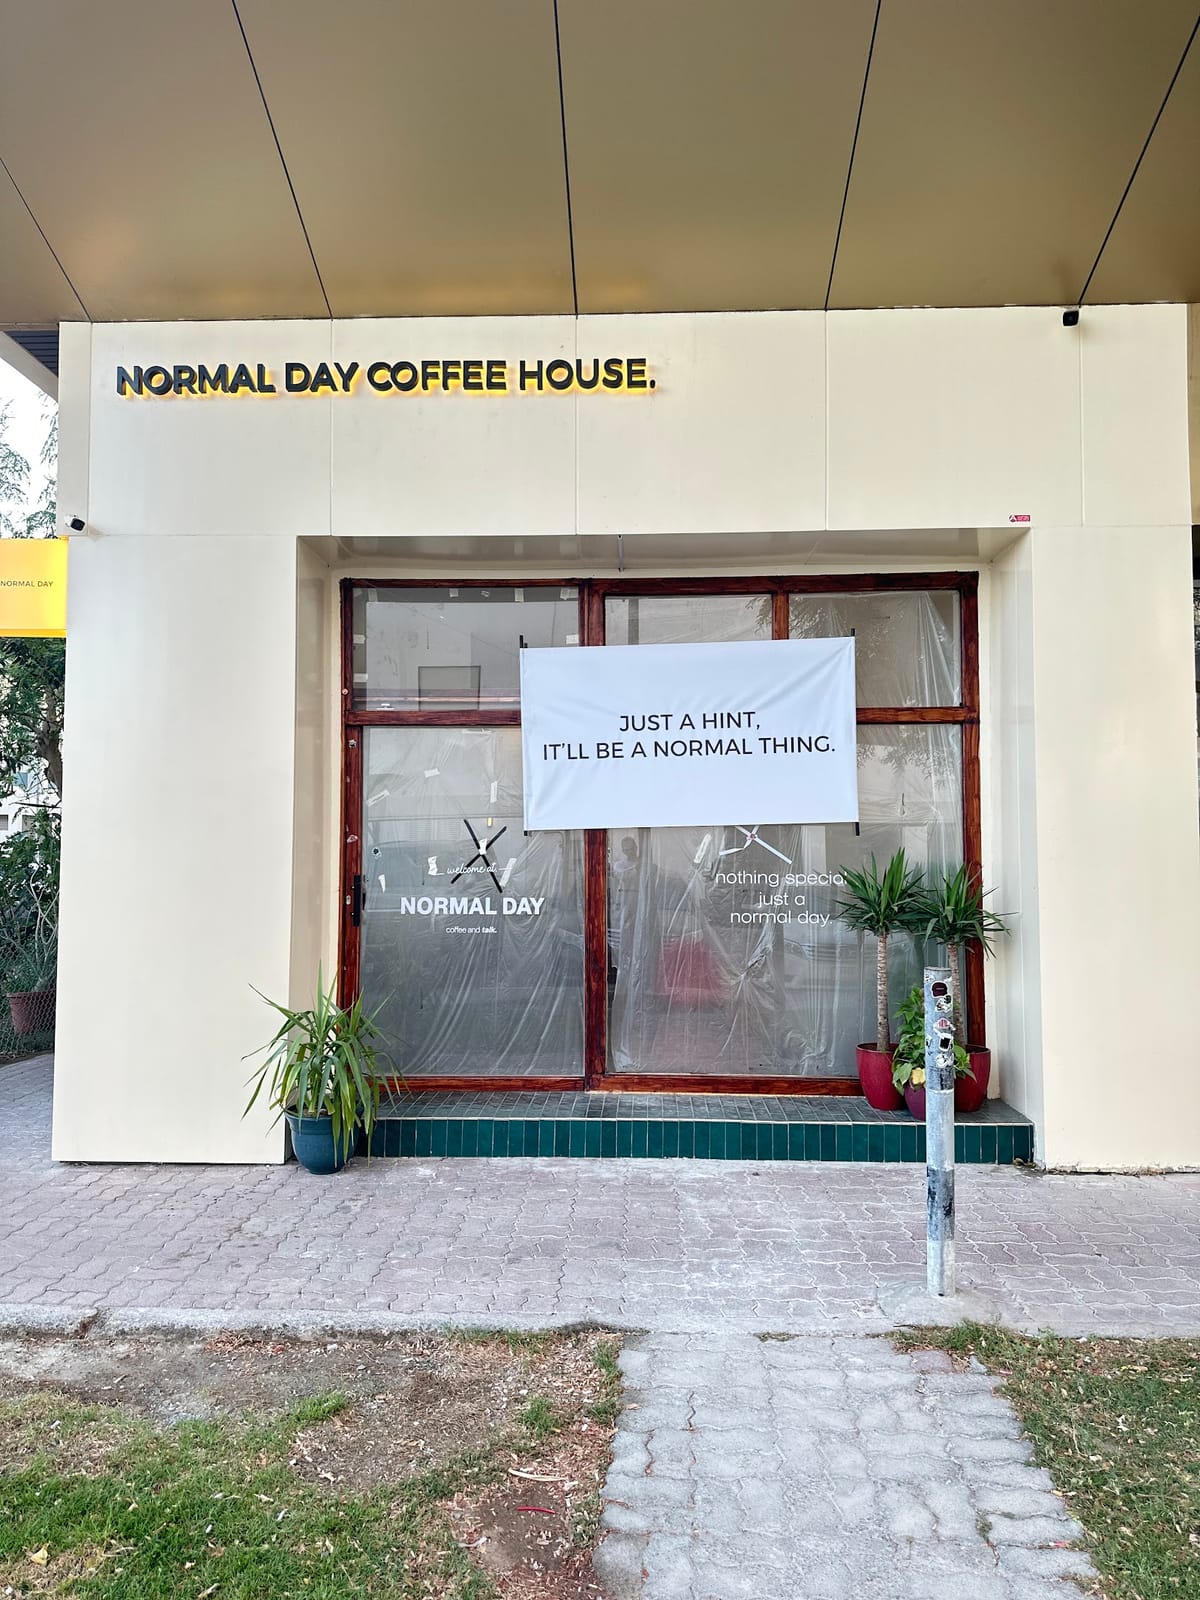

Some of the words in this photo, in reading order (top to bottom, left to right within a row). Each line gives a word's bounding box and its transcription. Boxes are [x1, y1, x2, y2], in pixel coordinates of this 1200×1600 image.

[116, 363, 276, 396] NORMAL
[285, 362, 359, 393] DAY
[367, 359, 507, 392] COFFEE
[519, 358, 656, 390] HOUSE.
[0, 580, 35, 588] NORMAL
[37, 580, 54, 588] DAY
[619, 713, 673, 732] JUST
[679, 713, 696, 730] A
[702, 711, 760, 731] HINT,
[543, 742, 590, 760] IT’LL
[596, 742, 624, 759] BE
[631, 741, 647, 758] A
[654, 738, 753, 757] NORMAL
[758, 735, 836, 754] THING.
[446, 862, 486, 874] welcome
[715, 870, 780, 888] nothing
[400, 896, 498, 915] NORMAL
[502, 897, 545, 915] DAY
[757, 891, 789, 909] just
[794, 894, 806, 906] a
[730, 910, 792, 924] normal
[797, 910, 833, 928] day.
[445, 926, 467, 934] coffee
[467, 926, 481, 934] and
